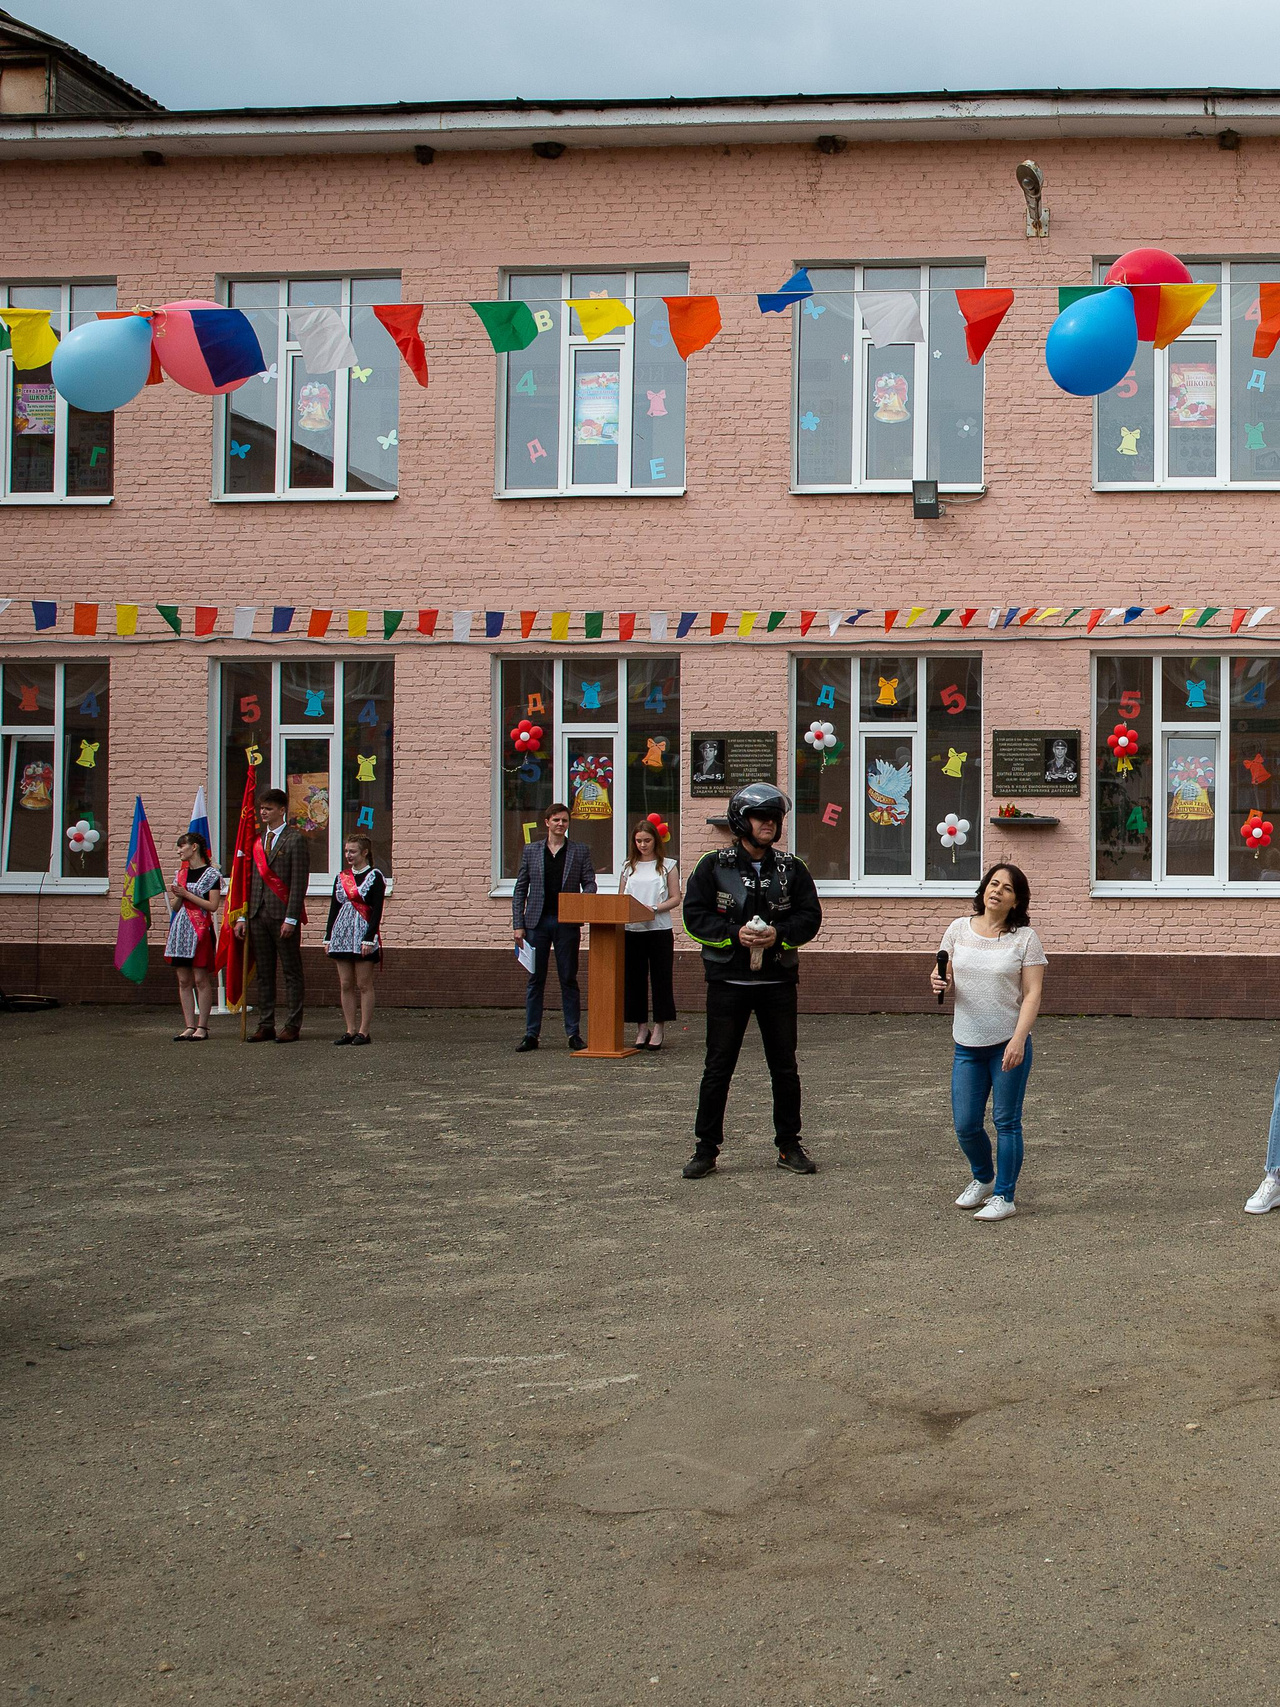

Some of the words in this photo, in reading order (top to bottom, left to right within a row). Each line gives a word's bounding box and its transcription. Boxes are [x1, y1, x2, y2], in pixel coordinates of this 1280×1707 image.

[534, 310, 553, 333] В
[516, 370, 537, 396] 4
[1117, 370, 1138, 398] 5
[1247, 369, 1266, 393] Д
[90, 446, 107, 467] Г
[527, 438, 547, 464] Д
[650, 457, 667, 480] Е
[80, 692, 101, 718] 4
[240, 694, 261, 723] 5
[527, 693, 546, 716] Д
[644, 686, 667, 714] 4
[817, 684, 836, 709] Д
[940, 684, 967, 715] 5
[1117, 690, 1141, 719] 5
[1244, 682, 1268, 710] 4
[358, 700, 380, 727] 4
[519, 755, 542, 783] 5
[356, 806, 374, 829] Д
[822, 802, 842, 827] Е
[1126, 806, 1147, 834] 4
[522, 822, 538, 844] Г
